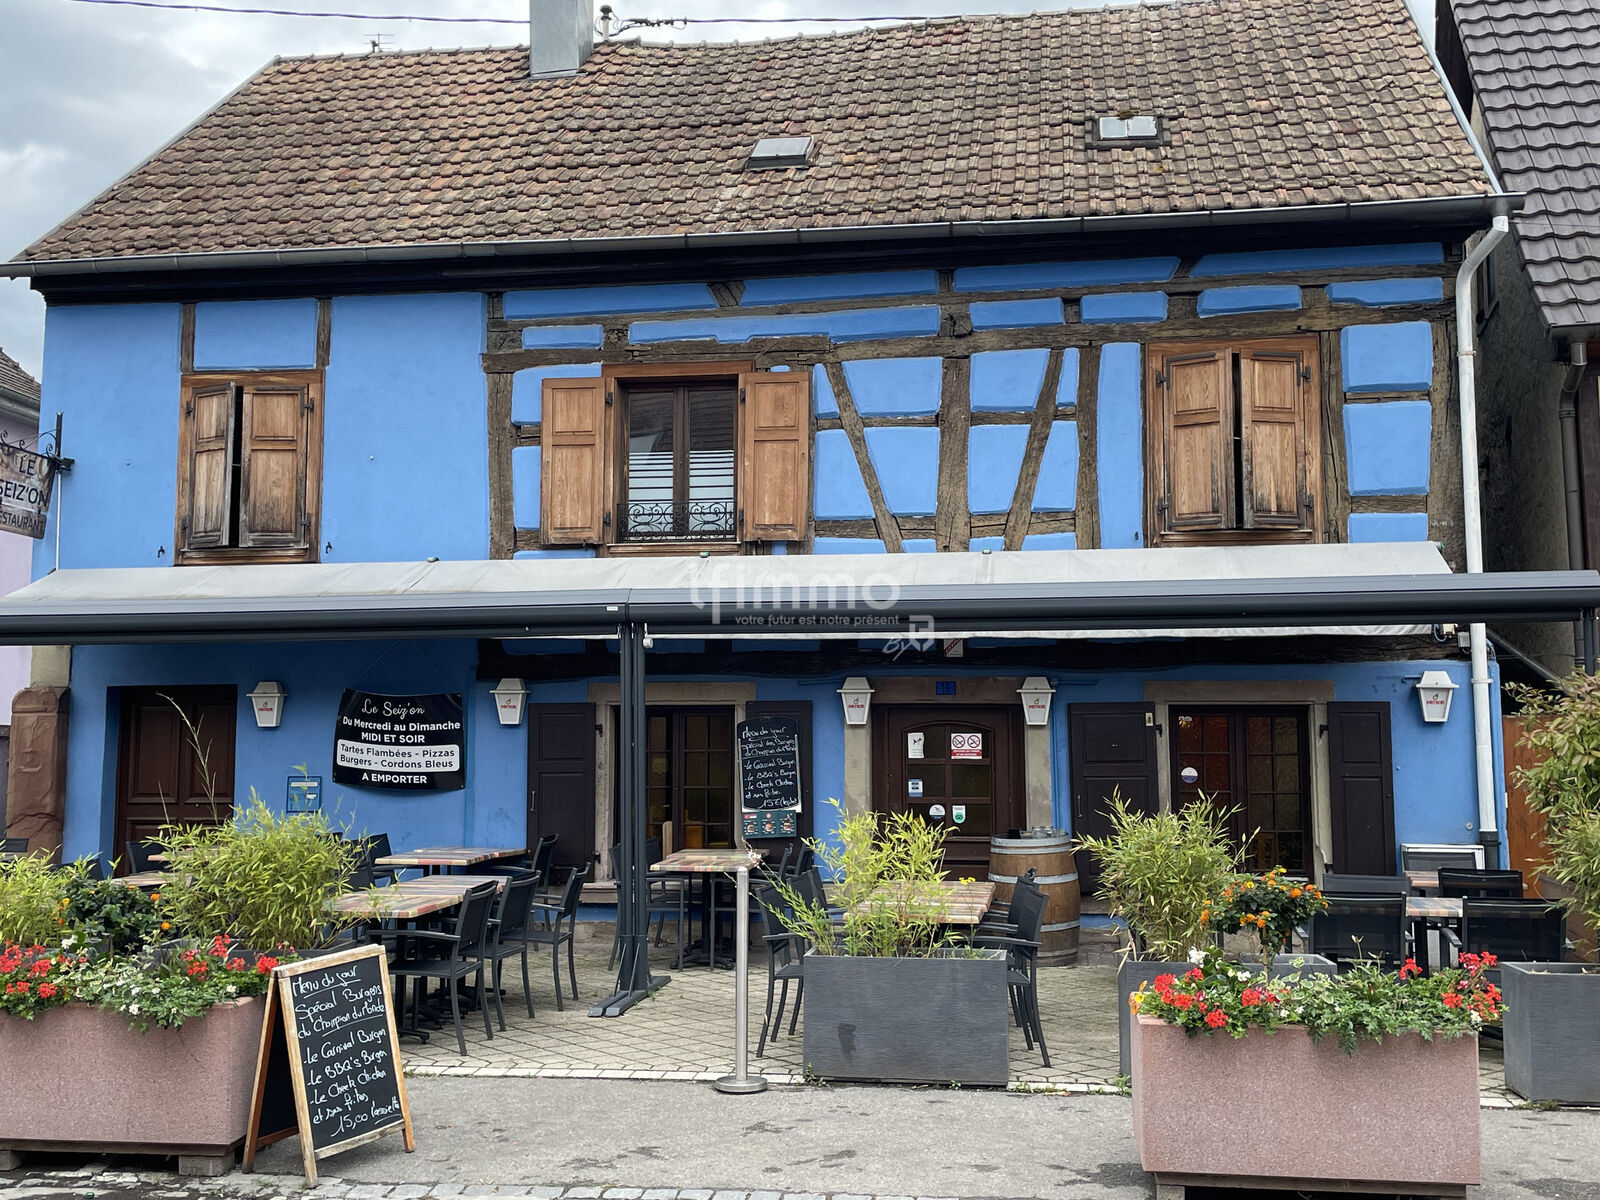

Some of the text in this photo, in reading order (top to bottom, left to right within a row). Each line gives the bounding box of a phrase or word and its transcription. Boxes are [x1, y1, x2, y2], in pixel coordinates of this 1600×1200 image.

[19, 457, 36, 477] LE
[361, 698, 425, 720] Le Seiz'on
[343, 716, 461, 731] Du Mercredi au Dimanche
[361, 732, 425, 743] MIDI ET SOIR
[340, 743, 364, 755] Tartes
[366, 747, 412, 757] Flambées
[422, 749, 455, 757] Pizzas
[340, 754, 372, 767] Burgers
[380, 759, 422, 768] Cordons
[425, 760, 453, 768] Bleus
[371, 773, 427, 784] EMPORTER
[292, 976, 319, 997] Menu
[321, 972, 335, 988] du
[294, 990, 338, 1023] Spécial
[297, 1022, 312, 1039] du
[313, 1012, 350, 1033] Champion
[321, 1031, 355, 1059] Carnival
[324, 1056, 362, 1079] BBQ's
[313, 1107, 324, 1124] et
[330, 1113, 369, 1138] 15,00
